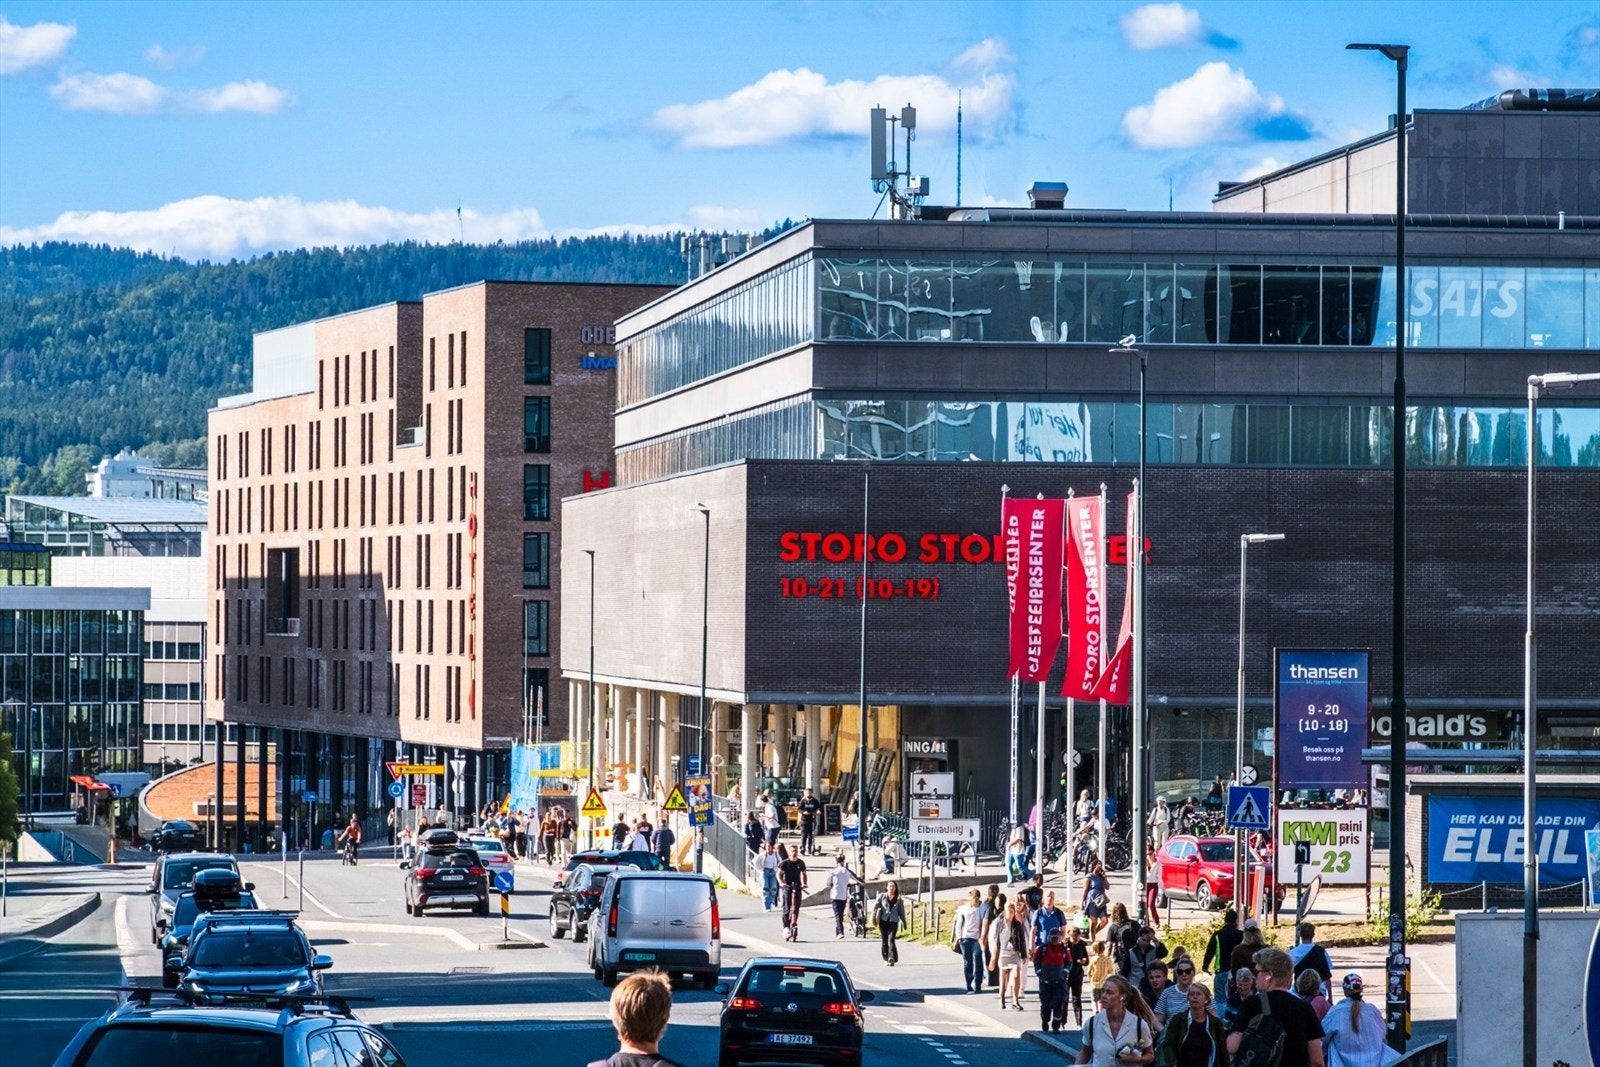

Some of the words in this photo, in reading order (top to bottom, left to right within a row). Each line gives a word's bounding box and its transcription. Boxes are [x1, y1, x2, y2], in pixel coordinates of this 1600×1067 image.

[1410, 279, 1524, 318] SATS
[780, 532, 907, 562] STORO
[1079, 508, 1100, 625] STORSENTER
[780, 578, 845, 598] 10-21
[856, 576, 940, 601] (10-19)
[1082, 630, 1099, 692] STORO
[1289, 664, 1358, 679] thansen
[1308, 704, 1315, 715] 9
[1325, 704, 1340, 715] 20
[1299, 718, 1319, 733] (10
[1329, 718, 1348, 733] 18)
[1371, 714, 1487, 736] onald's
[1335, 746, 1344, 754] på
[1450, 815, 1476, 824] HER
[1479, 815, 1505, 825] KAN
[1508, 816, 1525, 825] DU
[1536, 816, 1561, 826] ADE
[1564, 816, 1586, 826] DIN
[1283, 821, 1337, 846] KIWI
[1339, 820, 1362, 832] mini
[1339, 833, 1360, 847] pris
[1443, 827, 1579, 864] ELBIL
[1293, 850, 1352, 873] -23
